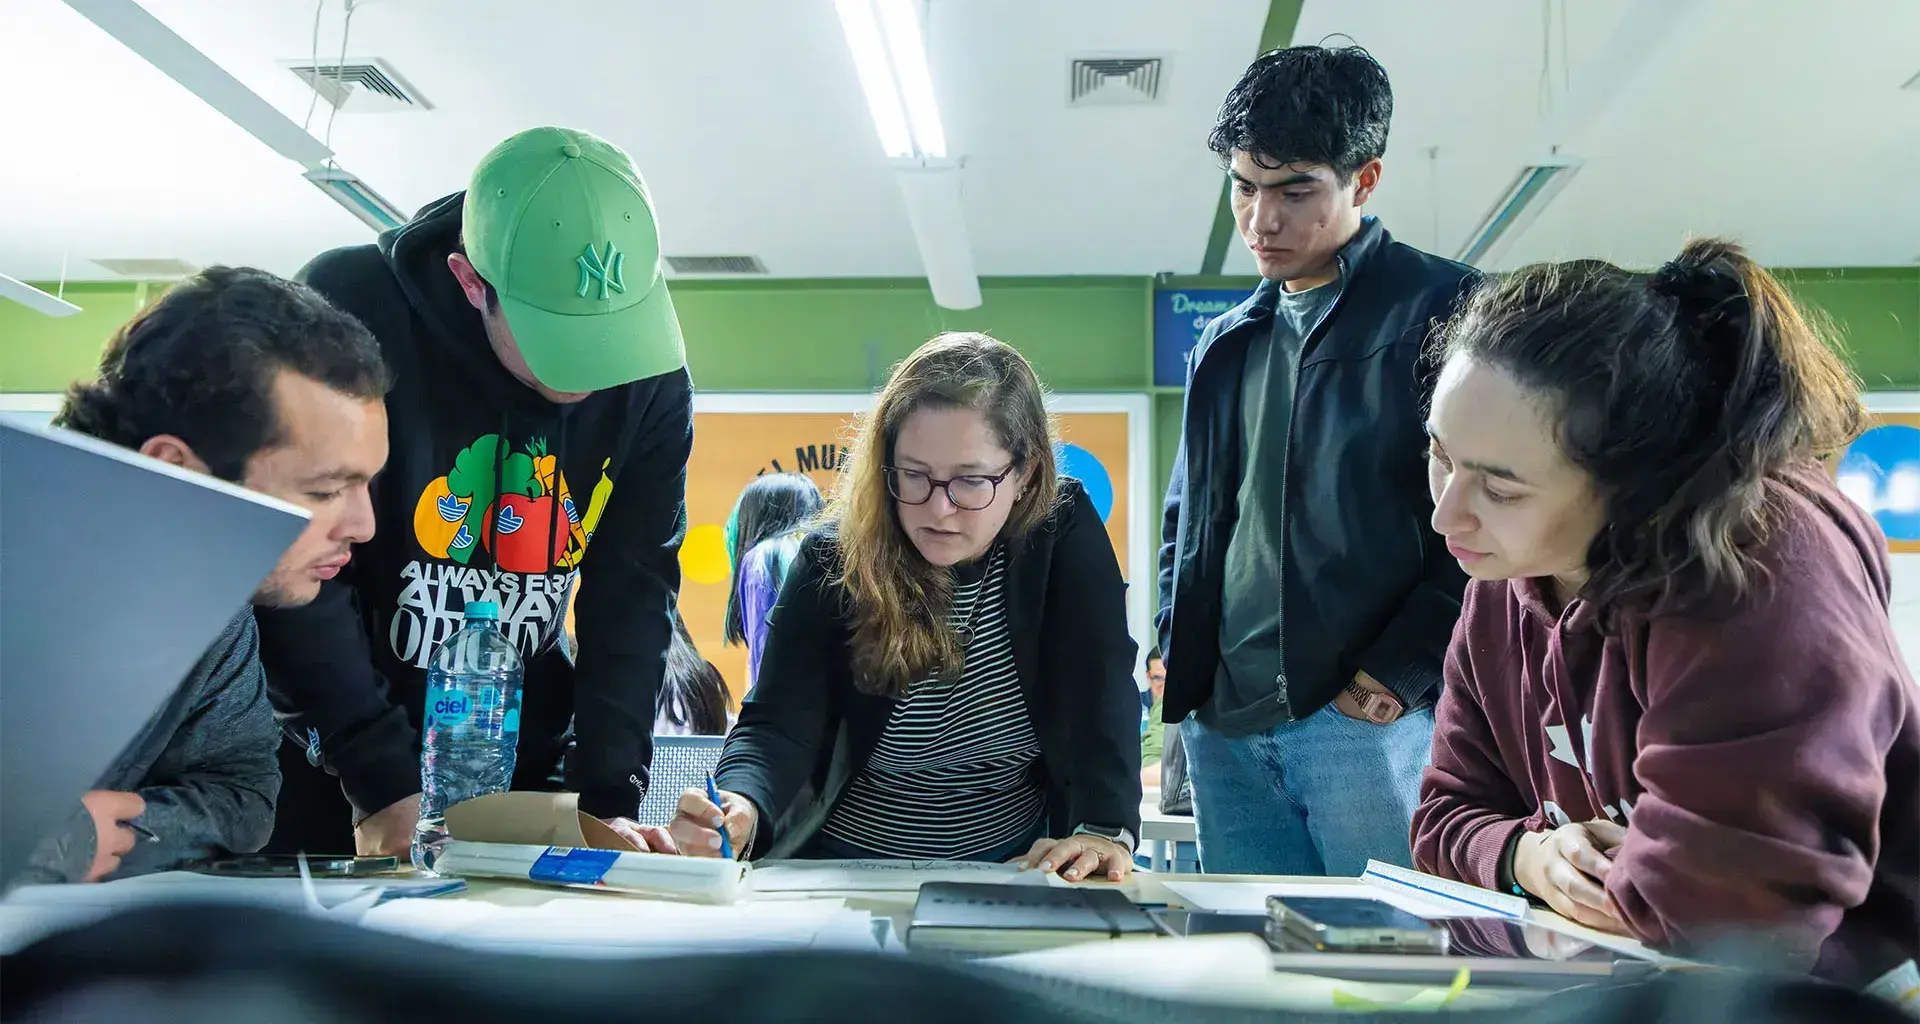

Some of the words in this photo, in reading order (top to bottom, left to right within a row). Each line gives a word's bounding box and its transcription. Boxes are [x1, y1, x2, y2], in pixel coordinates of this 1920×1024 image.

[576, 241, 627, 301] NY
[400, 560, 519, 594] ALWAYS
[435, 697, 468, 714] ciel
